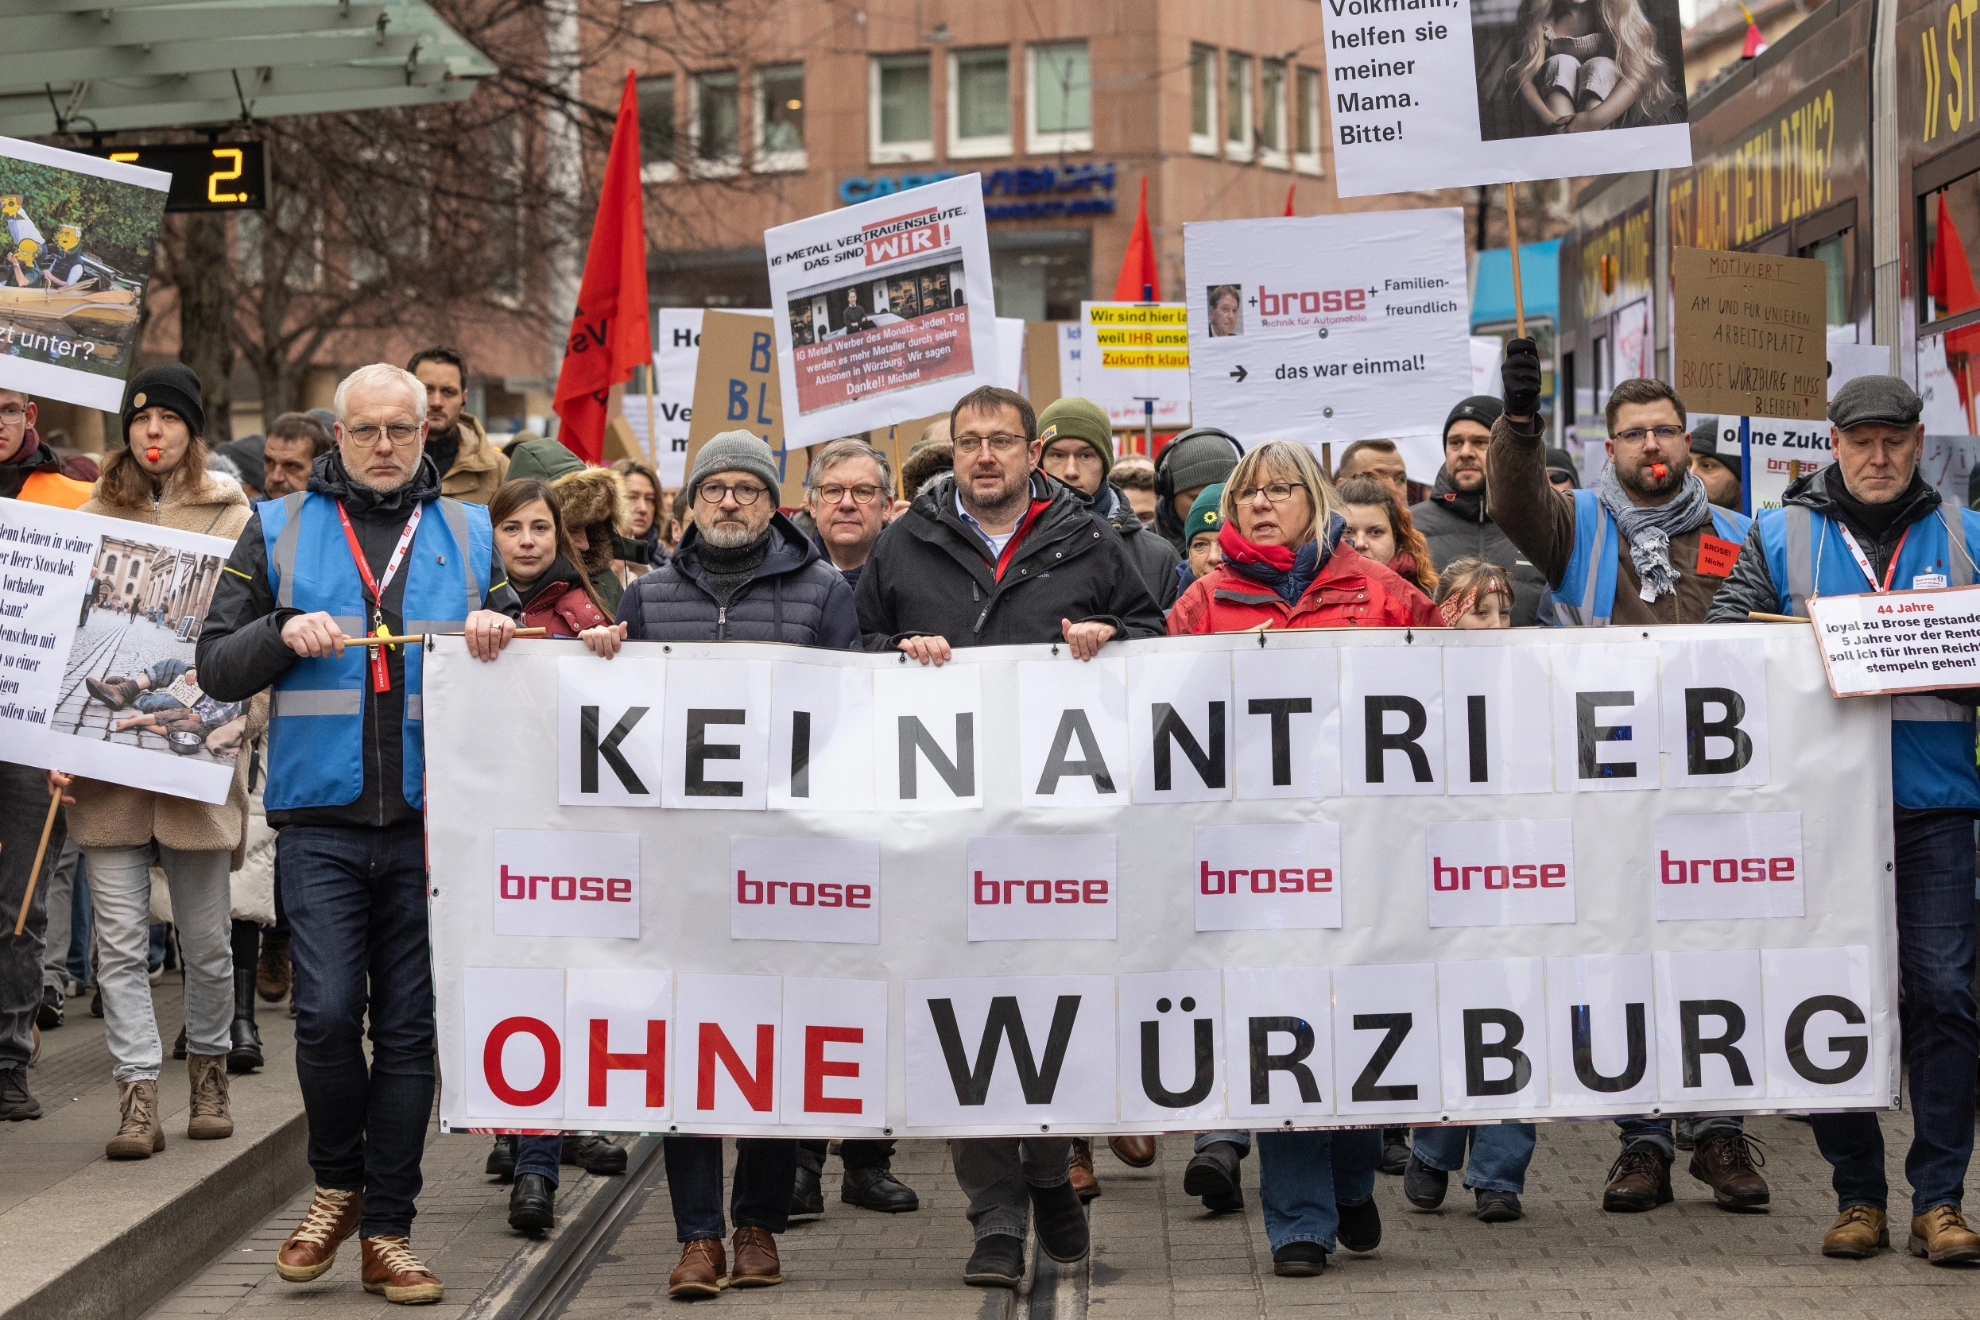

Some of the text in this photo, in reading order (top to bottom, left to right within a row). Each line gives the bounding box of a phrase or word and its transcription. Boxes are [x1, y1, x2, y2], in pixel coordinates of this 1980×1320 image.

[1331, 21, 1448, 49] helfen sie
[1334, 58, 1416, 81] meiner
[1337, 89, 1420, 113] Mama.
[1340, 120, 1403, 145] Bitte!
[1735, 128, 1773, 246] DEIN
[1781, 89, 1835, 224] DING?
[771, 256, 782, 267] IG
[786, 242, 832, 263] METALL
[837, 206, 966, 248] VERTRAUENSLEUTE.
[804, 257, 830, 271] DAS
[834, 247, 865, 263] SIND
[1710, 257, 1784, 280] MOTIVIERT
[1385, 277, 1450, 291] Familien-
[1259, 285, 1366, 316] brose
[1385, 301, 1458, 317] freundlich
[1691, 296, 1710, 312] AM
[1719, 299, 1739, 316] UND
[1765, 306, 1811, 326] UNSEREN
[1090, 310, 1114, 321] Wir
[1118, 311, 1147, 322] sind
[1150, 312, 1174, 322] hier
[1298, 317, 1310, 326] für
[1314, 314, 1367, 325] Automobile
[20, 331, 95, 361] unter?
[797, 311, 966, 362] IG Metall Werber des Monats. Jeden Tag
[1097, 332, 1187, 344] weil IHR unse
[1713, 324, 1804, 355] ARBEITSPLATZ
[806, 329, 958, 374] werden es mehr Metaller durch seine
[1102, 353, 1154, 366] Zukunft
[815, 346, 951, 386] Aktionen in Würzburg. Wir sagen
[1275, 354, 1426, 381] das war einmal!
[1682, 359, 1821, 396] BROSE WÜRZBURG MUSS
[846, 369, 920, 396] Danke!! Michael
[20, 526, 52, 547] keinen
[52, 532, 63, 549] in
[63, 536, 94, 554] seiner
[1704, 542, 1732, 557] BROSE!
[10, 550, 33, 569] Herr
[33, 554, 76, 577] Stoschek
[1705, 556, 1725, 568] Nicht
[3, 573, 45, 597] Vorhaben
[0, 599, 29, 618] kann?
[1877, 602, 1935, 614] 44 Jahre
[0, 624, 56, 650] enschen mit
[1826, 621, 1861, 634] loyal
[1862, 621, 1879, 630] zu
[1881, 617, 1920, 629] Brose
[1842, 636, 1851, 646] 5
[1854, 632, 1892, 646] Jahre
[1894, 632, 1917, 642] vor
[1920, 630, 1941, 640] der
[4, 654, 15, 668] so
[15, 654, 41, 672] einer
[1829, 643, 1980, 661] soll ich für Ihren Reich
[1866, 657, 1976, 674] stempeln gehen!
[25, 706, 46, 725] sind.
[580, 687, 1754, 800] KEIN ANTRIEB
[500, 850, 1795, 909] brose brose brose brose brose brose
[483, 994, 1870, 1115] OHNE WÜRZBURG
